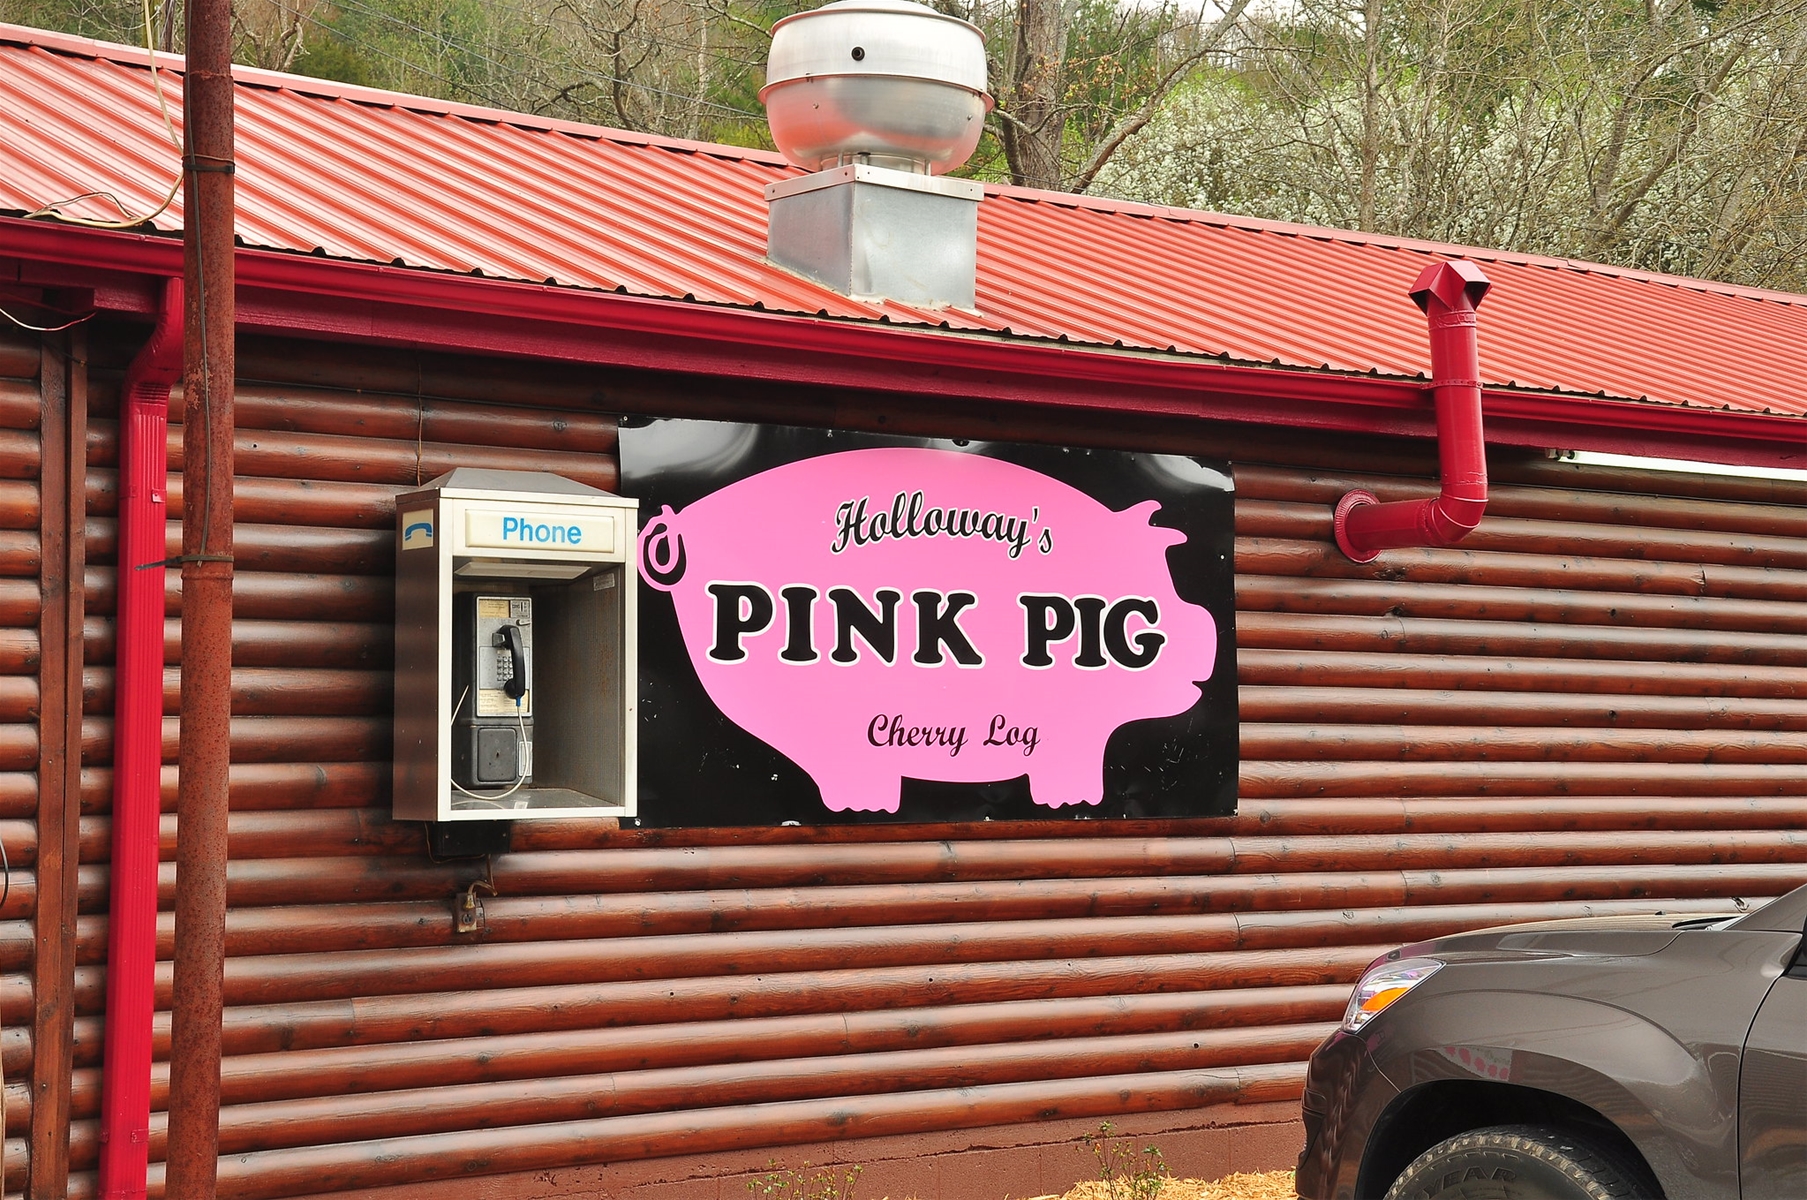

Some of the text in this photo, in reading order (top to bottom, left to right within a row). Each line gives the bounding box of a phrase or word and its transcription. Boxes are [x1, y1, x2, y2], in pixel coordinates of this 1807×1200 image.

[502, 516, 583, 545] Phone
[830, 490, 1054, 560] Holloway's
[706, 582, 1167, 670] PINK PIG
[867, 714, 1040, 757] Cherry Log
